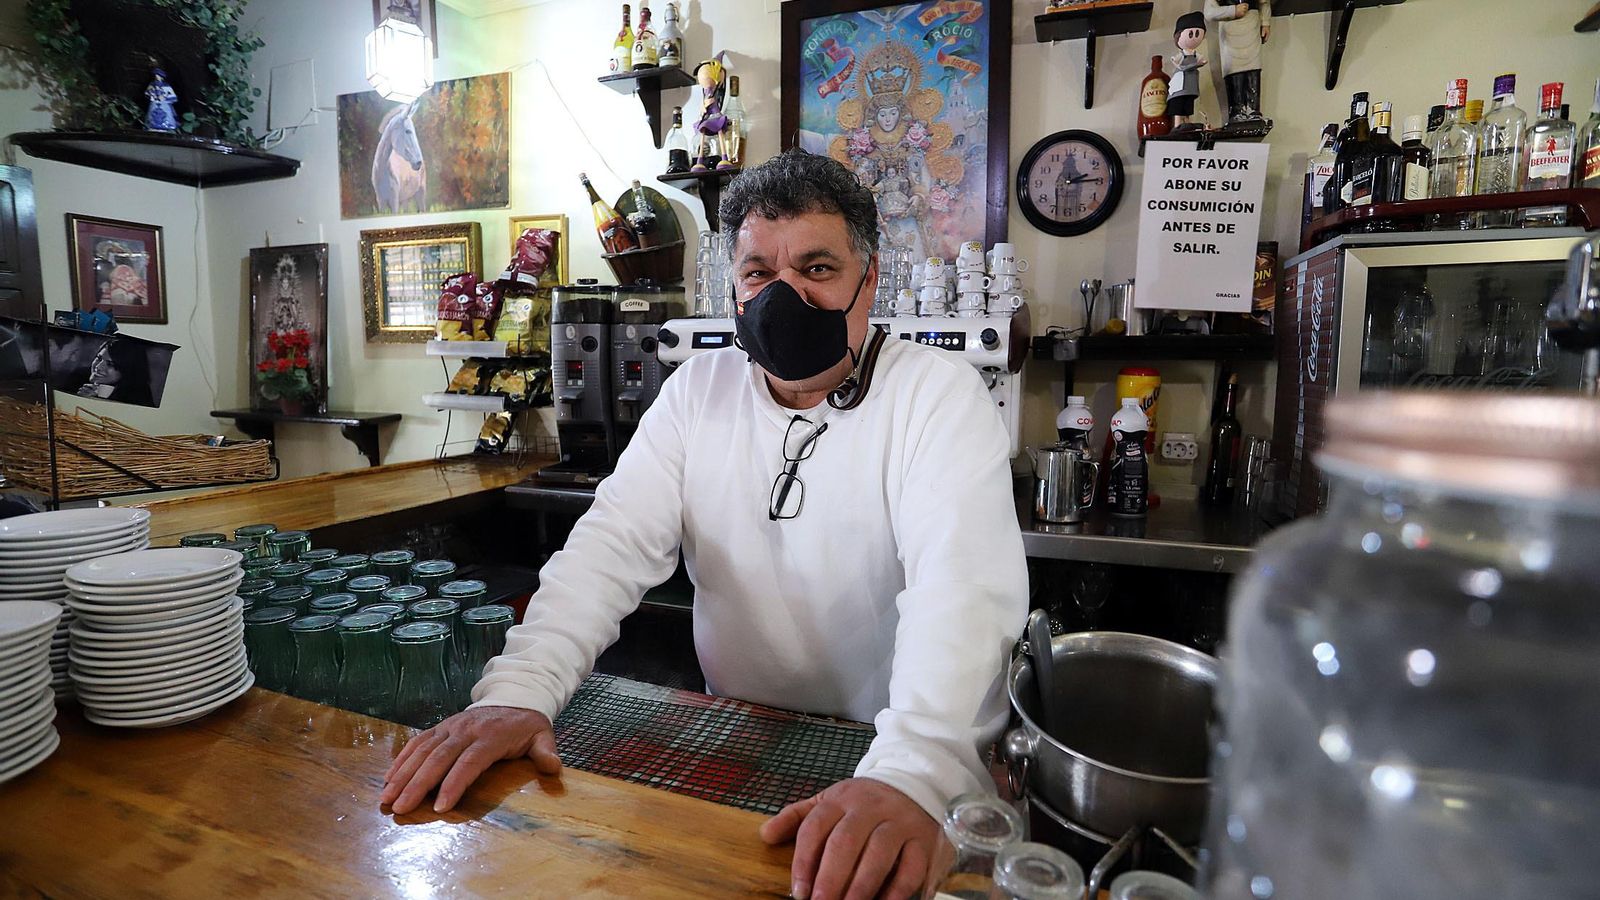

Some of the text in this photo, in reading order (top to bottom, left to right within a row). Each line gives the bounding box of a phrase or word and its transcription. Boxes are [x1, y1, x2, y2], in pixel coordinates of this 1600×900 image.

[1066, 148, 1077, 157] 12
[1051, 154, 1060, 162] 11
[1530, 156, 1570, 167] BEEFEATER
[1092, 159, 1100, 170] 2
[1162, 157, 1249, 170] POR FAVOR
[1040, 166, 1051, 175] 10
[1034, 180, 1043, 189] 9
[1095, 177, 1104, 186] 3
[1164, 179, 1242, 192] ABONE SU
[1039, 194, 1048, 203] 8
[1089, 192, 1098, 201] 4
[1049, 204, 1057, 214] 7
[1078, 203, 1087, 213] 5
[1147, 199, 1255, 214] CONSUMICIÓN
[1063, 208, 1072, 217] 6
[1161, 221, 1236, 235] ANTES DE
[1172, 242, 1220, 255] SALIR.
